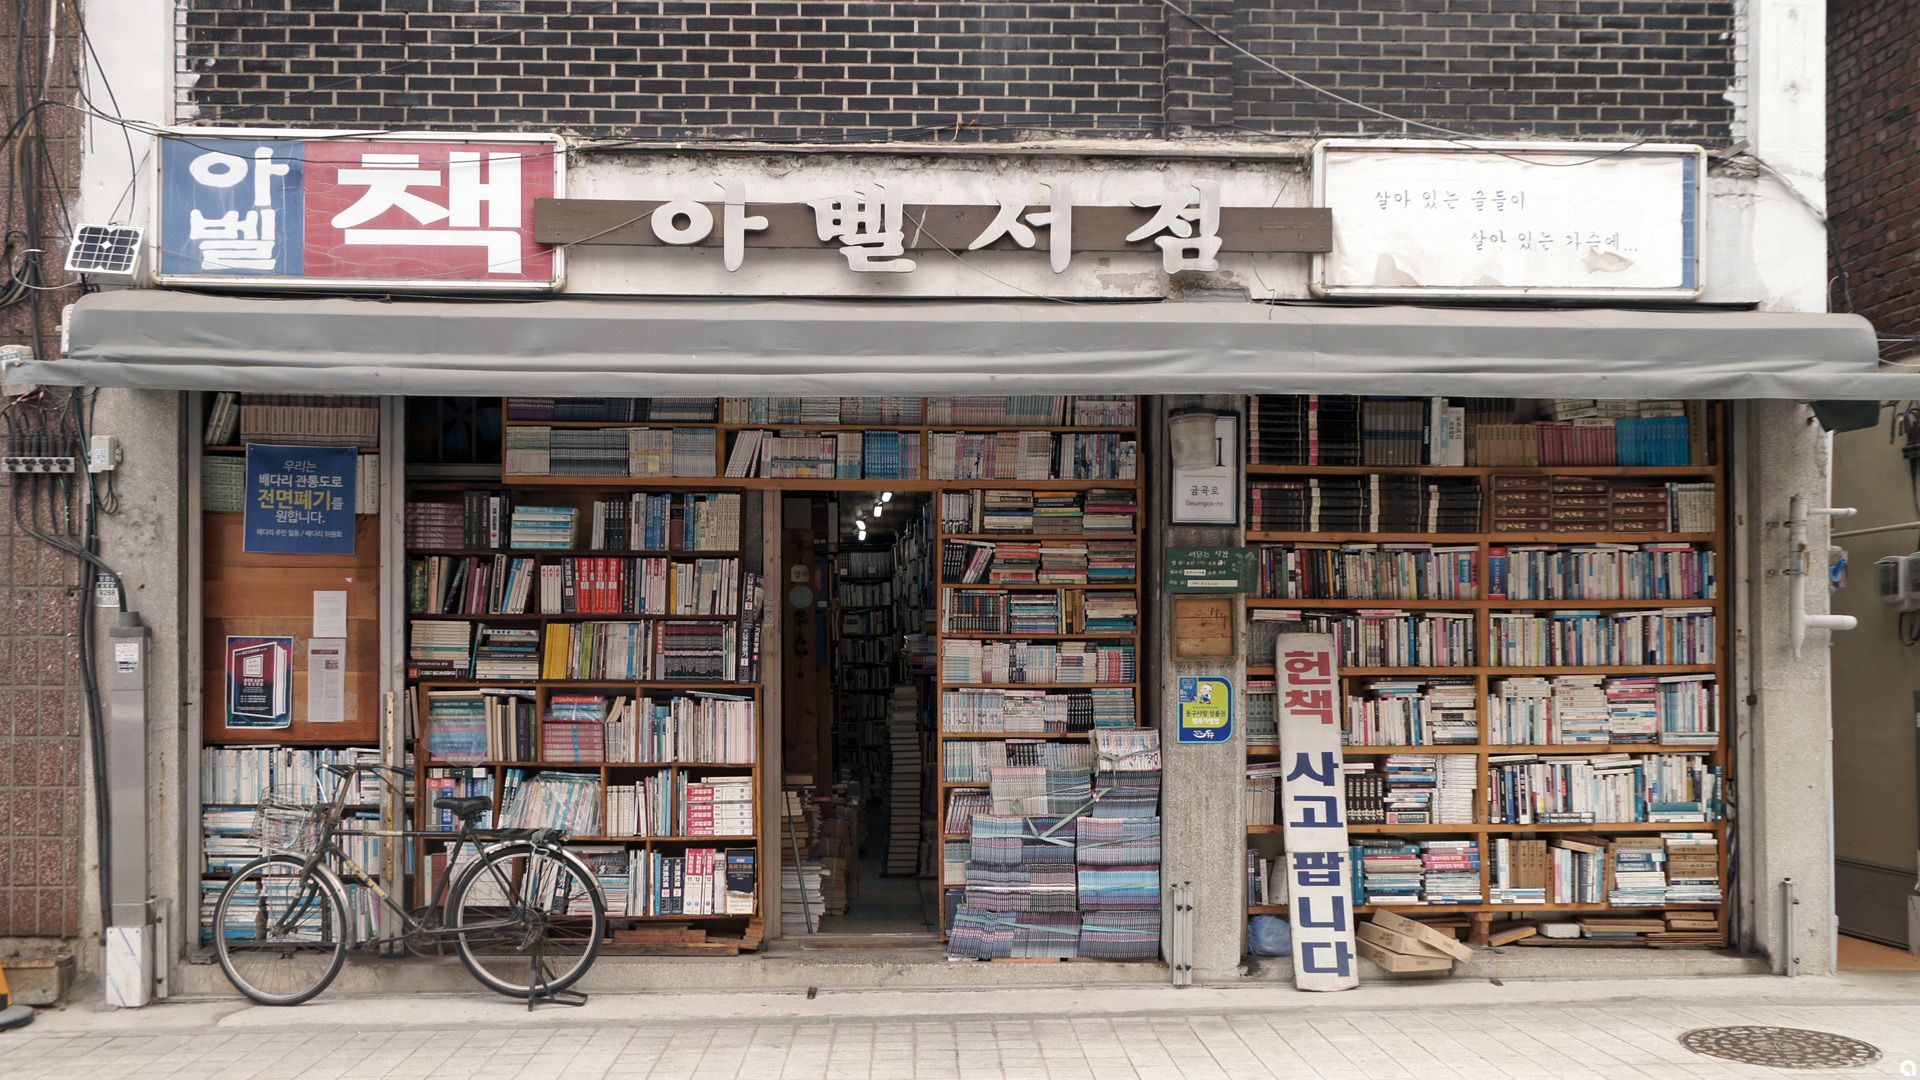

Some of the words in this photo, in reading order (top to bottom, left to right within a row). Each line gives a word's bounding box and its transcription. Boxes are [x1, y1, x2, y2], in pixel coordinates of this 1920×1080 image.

[188, 146, 290, 271] 아벨
[1374, 190, 1410, 210] 살아
[1423, 190, 1459, 211] 있는
[1470, 190, 1526, 212] 글들이
[331, 151, 523, 274] 책
[1470, 231, 1506, 251] 살아
[1518, 231, 1554, 251] 있는
[283, 460, 318, 473] 우리는
[259, 473, 293, 488] 배다리
[295, 474, 343, 488] 관통도로
[257, 488, 344, 512] 전면폐기를
[1190, 485, 1220, 497] 금곡로
[1185, 499, 1224, 508] Geumgok-ro
[275, 509, 326, 524] 원합니다.
[1284, 649, 1333, 725] 헌책
